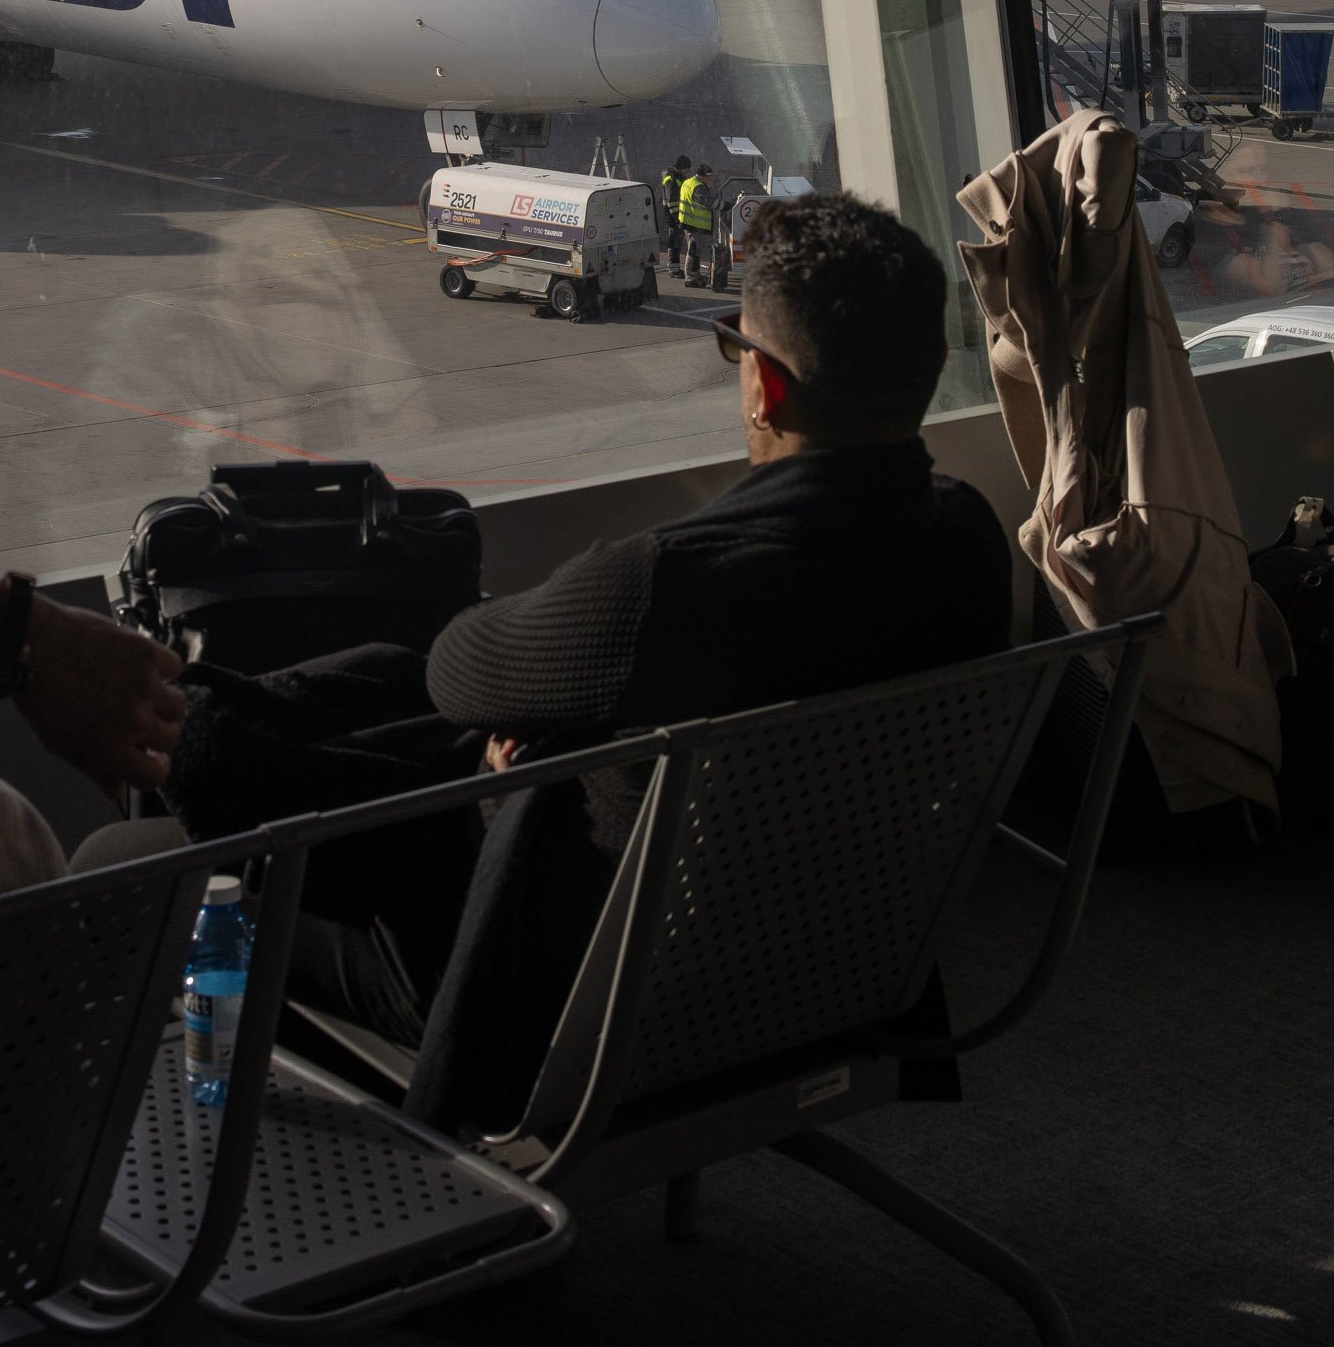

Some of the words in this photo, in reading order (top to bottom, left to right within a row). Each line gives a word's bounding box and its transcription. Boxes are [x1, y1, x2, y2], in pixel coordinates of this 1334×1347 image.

[453, 124, 470, 141] RC
[450, 191, 477, 210] 2521
[535, 197, 580, 214] AIRPORT
[463, 216, 482, 225] POWER
[530, 208, 580, 226] SERVICES
[543, 228, 564, 237] TAURUS
[1268, 324, 1284, 333] AOG:
